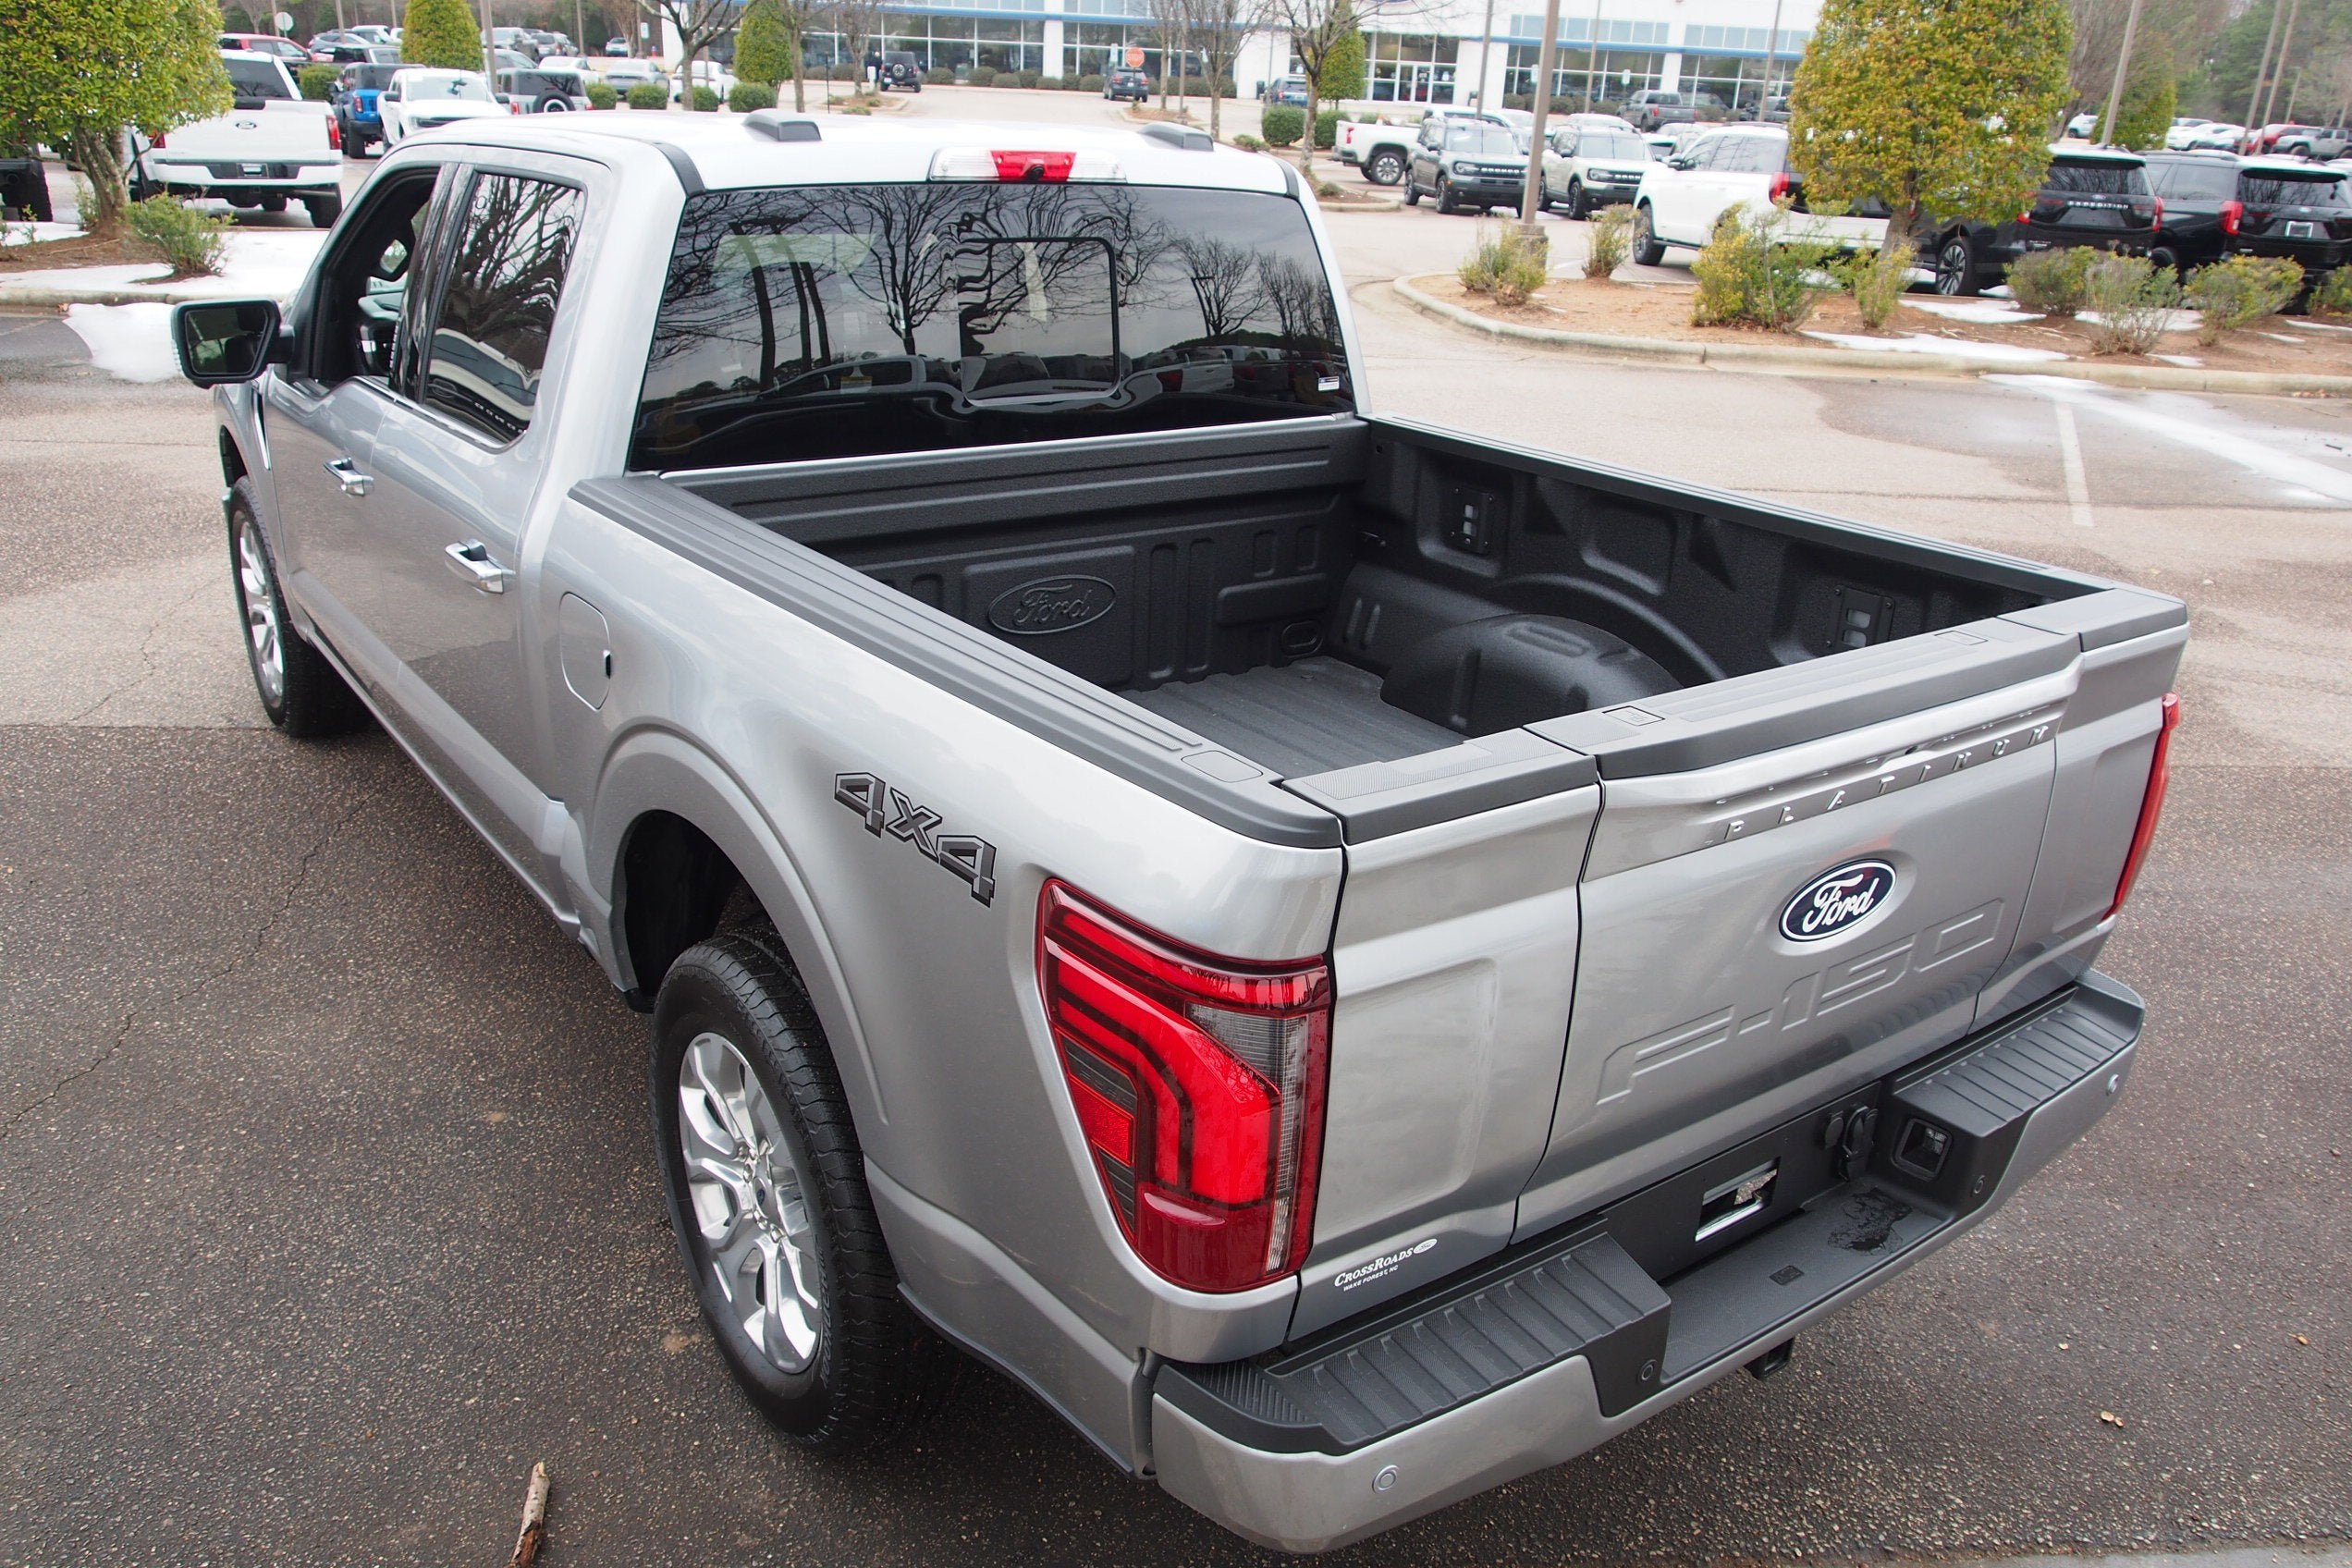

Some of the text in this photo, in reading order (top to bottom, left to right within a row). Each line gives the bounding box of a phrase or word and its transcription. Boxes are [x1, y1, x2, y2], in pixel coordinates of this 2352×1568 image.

[2067, 200, 2129, 209] EXPEDITION
[1012, 583, 1093, 628] Ford
[1723, 725, 2051, 842] PLATINUM
[1801, 873, 1875, 933] Ford
[1596, 899, 2004, 1107] F-150
[1343, 1280, 1363, 1292] WAKE
[1389, 1265, 1399, 1273] NC
